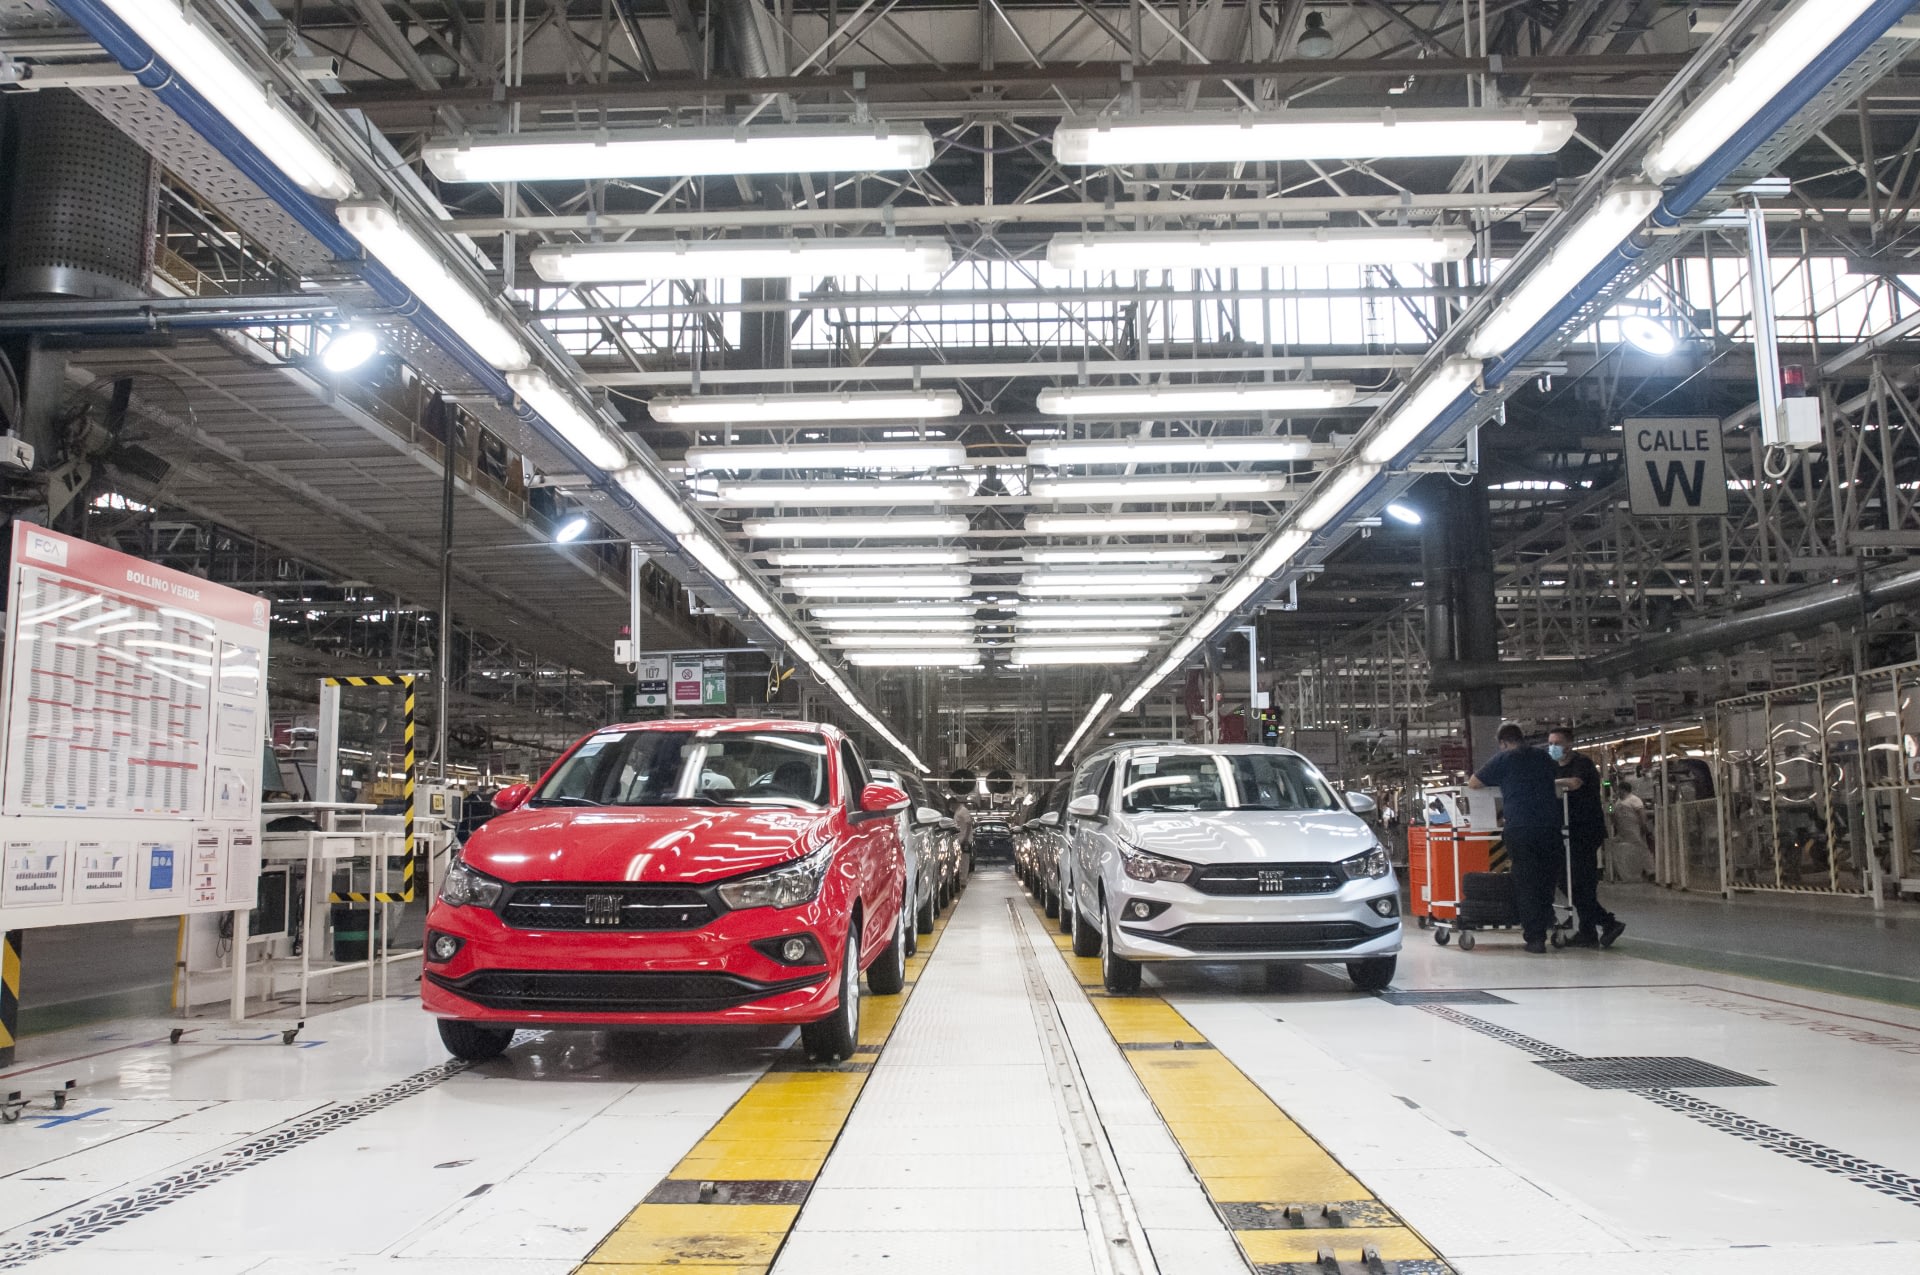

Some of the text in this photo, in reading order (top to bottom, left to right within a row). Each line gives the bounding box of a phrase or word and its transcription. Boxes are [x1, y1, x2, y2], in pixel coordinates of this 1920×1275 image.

[1637, 429, 1709, 452] CALLE
[1645, 460, 1705, 507] W
[34, 538, 60, 557] FCA
[126, 570, 200, 601] BOLLINO VERDE
[645, 667, 660, 679] 107
